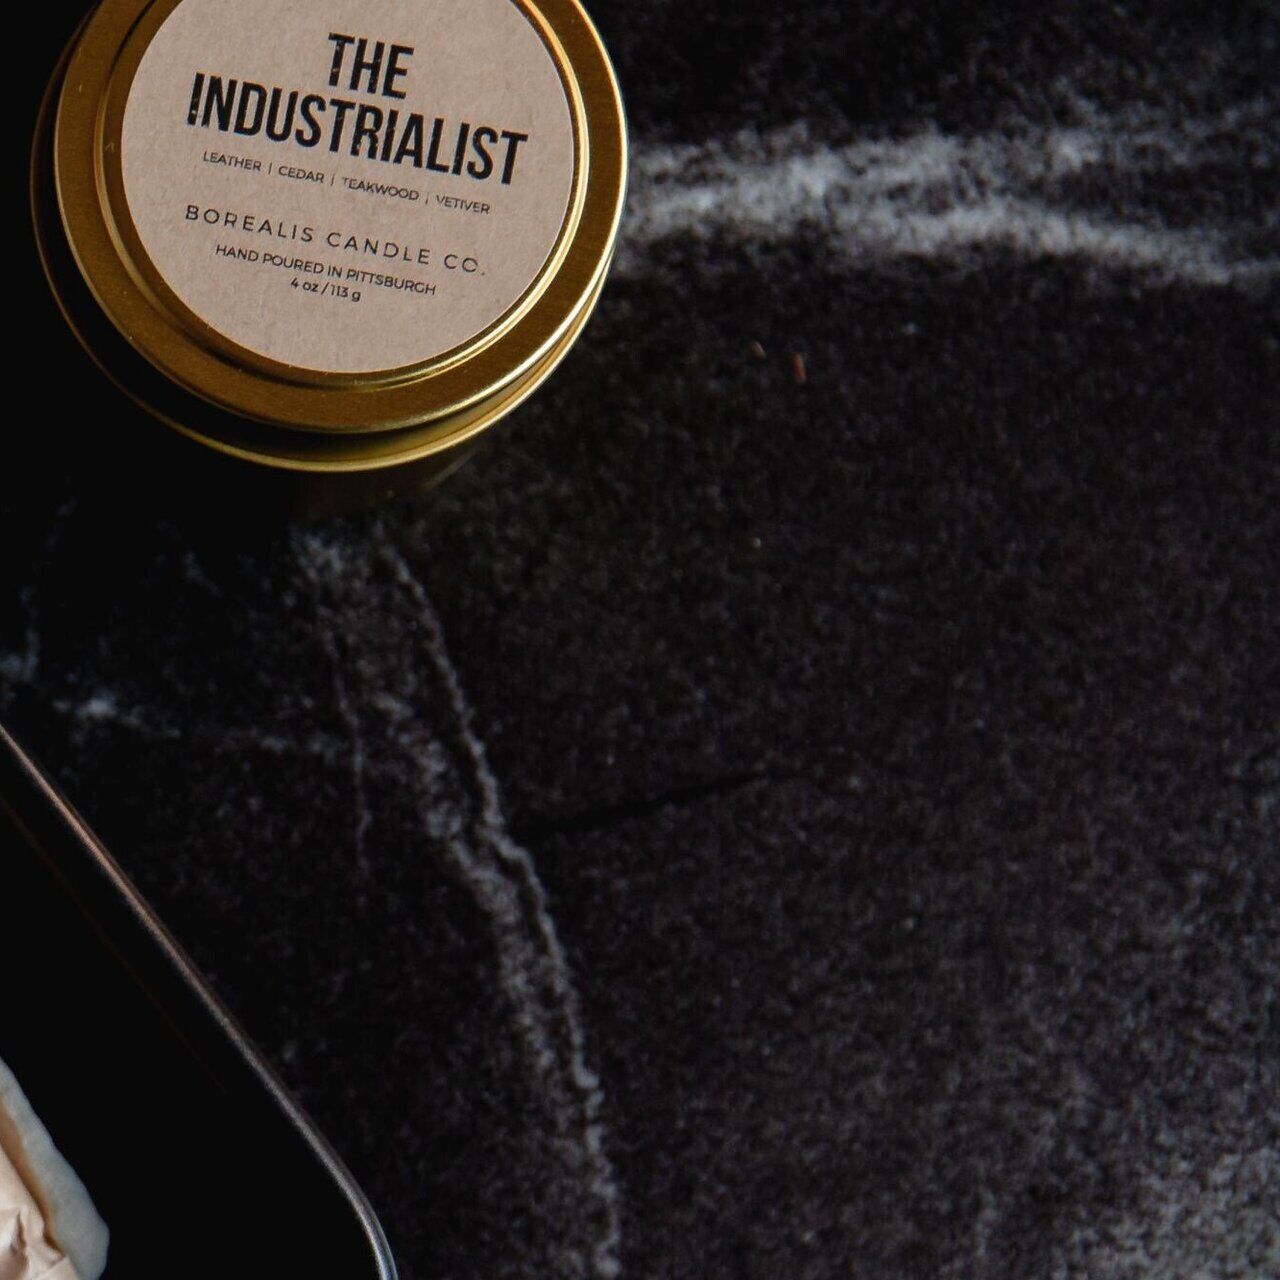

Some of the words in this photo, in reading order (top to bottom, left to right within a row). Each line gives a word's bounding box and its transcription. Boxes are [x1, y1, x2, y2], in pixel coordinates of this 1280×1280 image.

[328, 32, 415, 100] THE
[187, 72, 529, 185] INDUSTRIALIST
[203, 151, 262, 172] LEATHER
[278, 165, 325, 184] CEDAR
[342, 177, 420, 201] TEAKWOOD
[436, 194, 490, 215] VETIVER
[185, 204, 315, 243] BOREALIS
[326, 231, 431, 265] CANDLE
[443, 253, 486, 276] CO.
[215, 243, 259, 262] HAND
[262, 252, 325, 275] POURED
[327, 265, 343, 279] IN
[346, 268, 437, 296] PITTSBURGH
[290, 277, 300, 289] 4
[302, 281, 319, 293] oz
[351, 291, 362, 303] g
